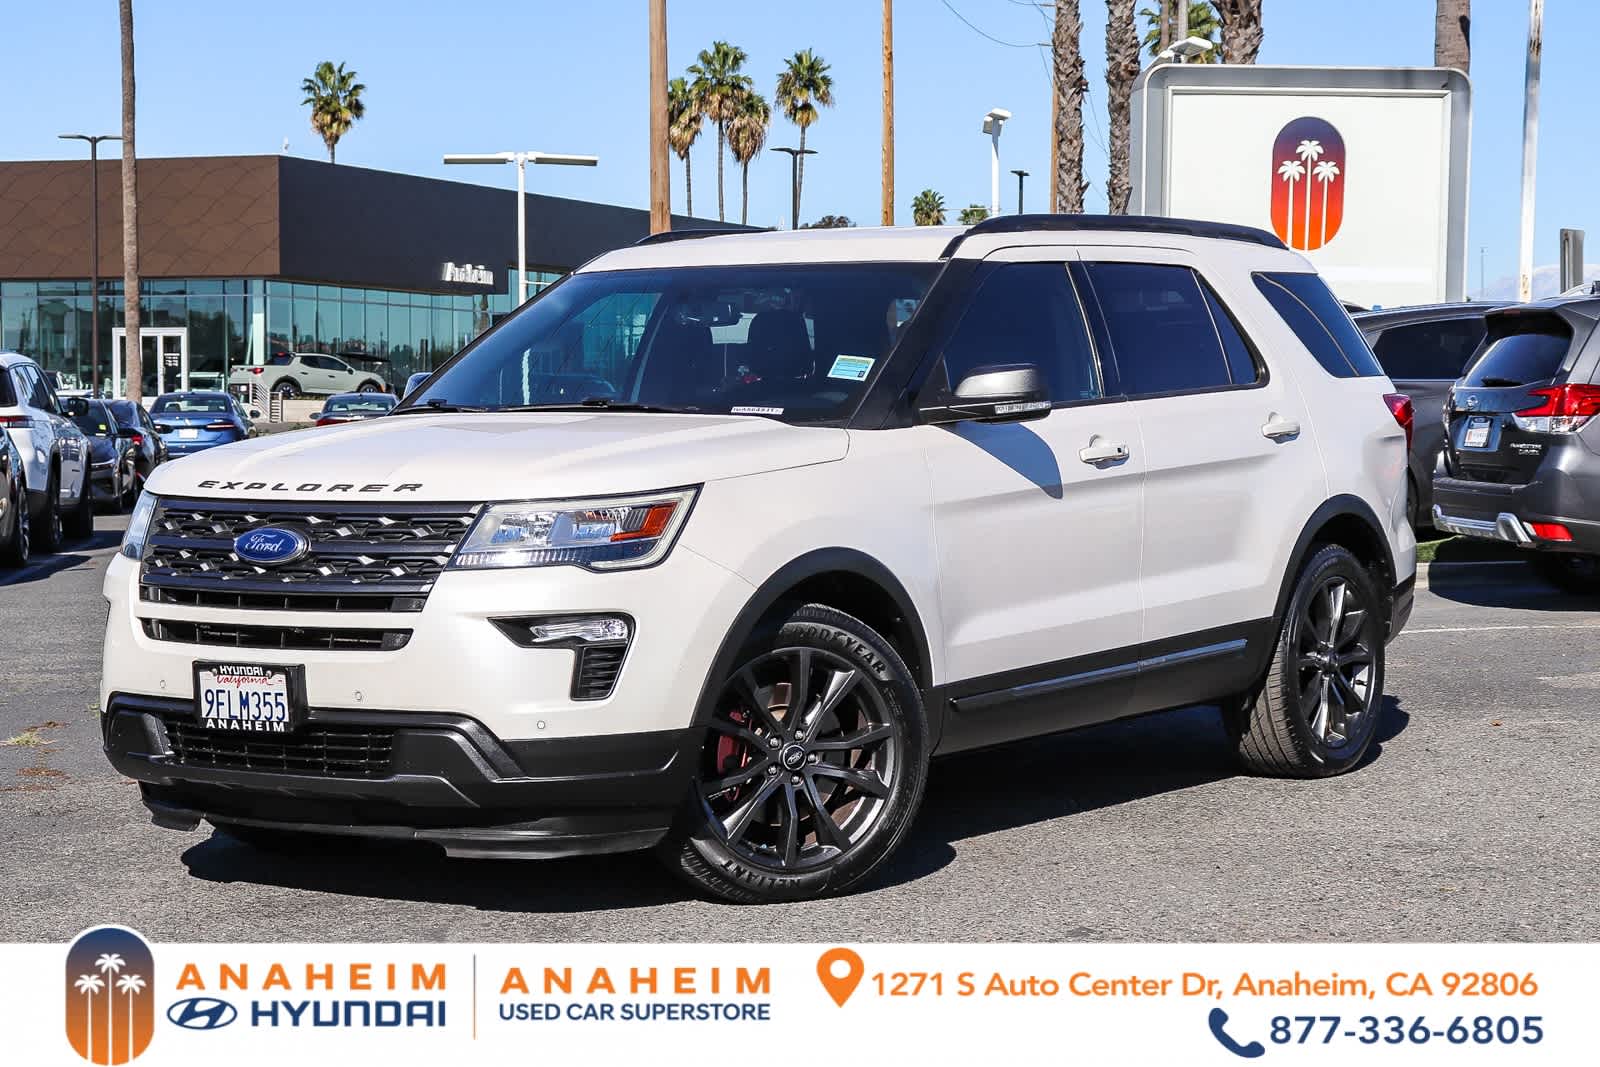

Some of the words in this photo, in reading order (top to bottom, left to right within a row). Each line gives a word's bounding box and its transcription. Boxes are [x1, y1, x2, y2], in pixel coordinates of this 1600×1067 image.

[198, 480, 423, 493] EXPLORER
[244, 534, 282, 553] Ford
[219, 665, 264, 676] HYUNDAI
[204, 688, 286, 721] 9FLM355
[206, 718, 285, 732] ANAHEIM
